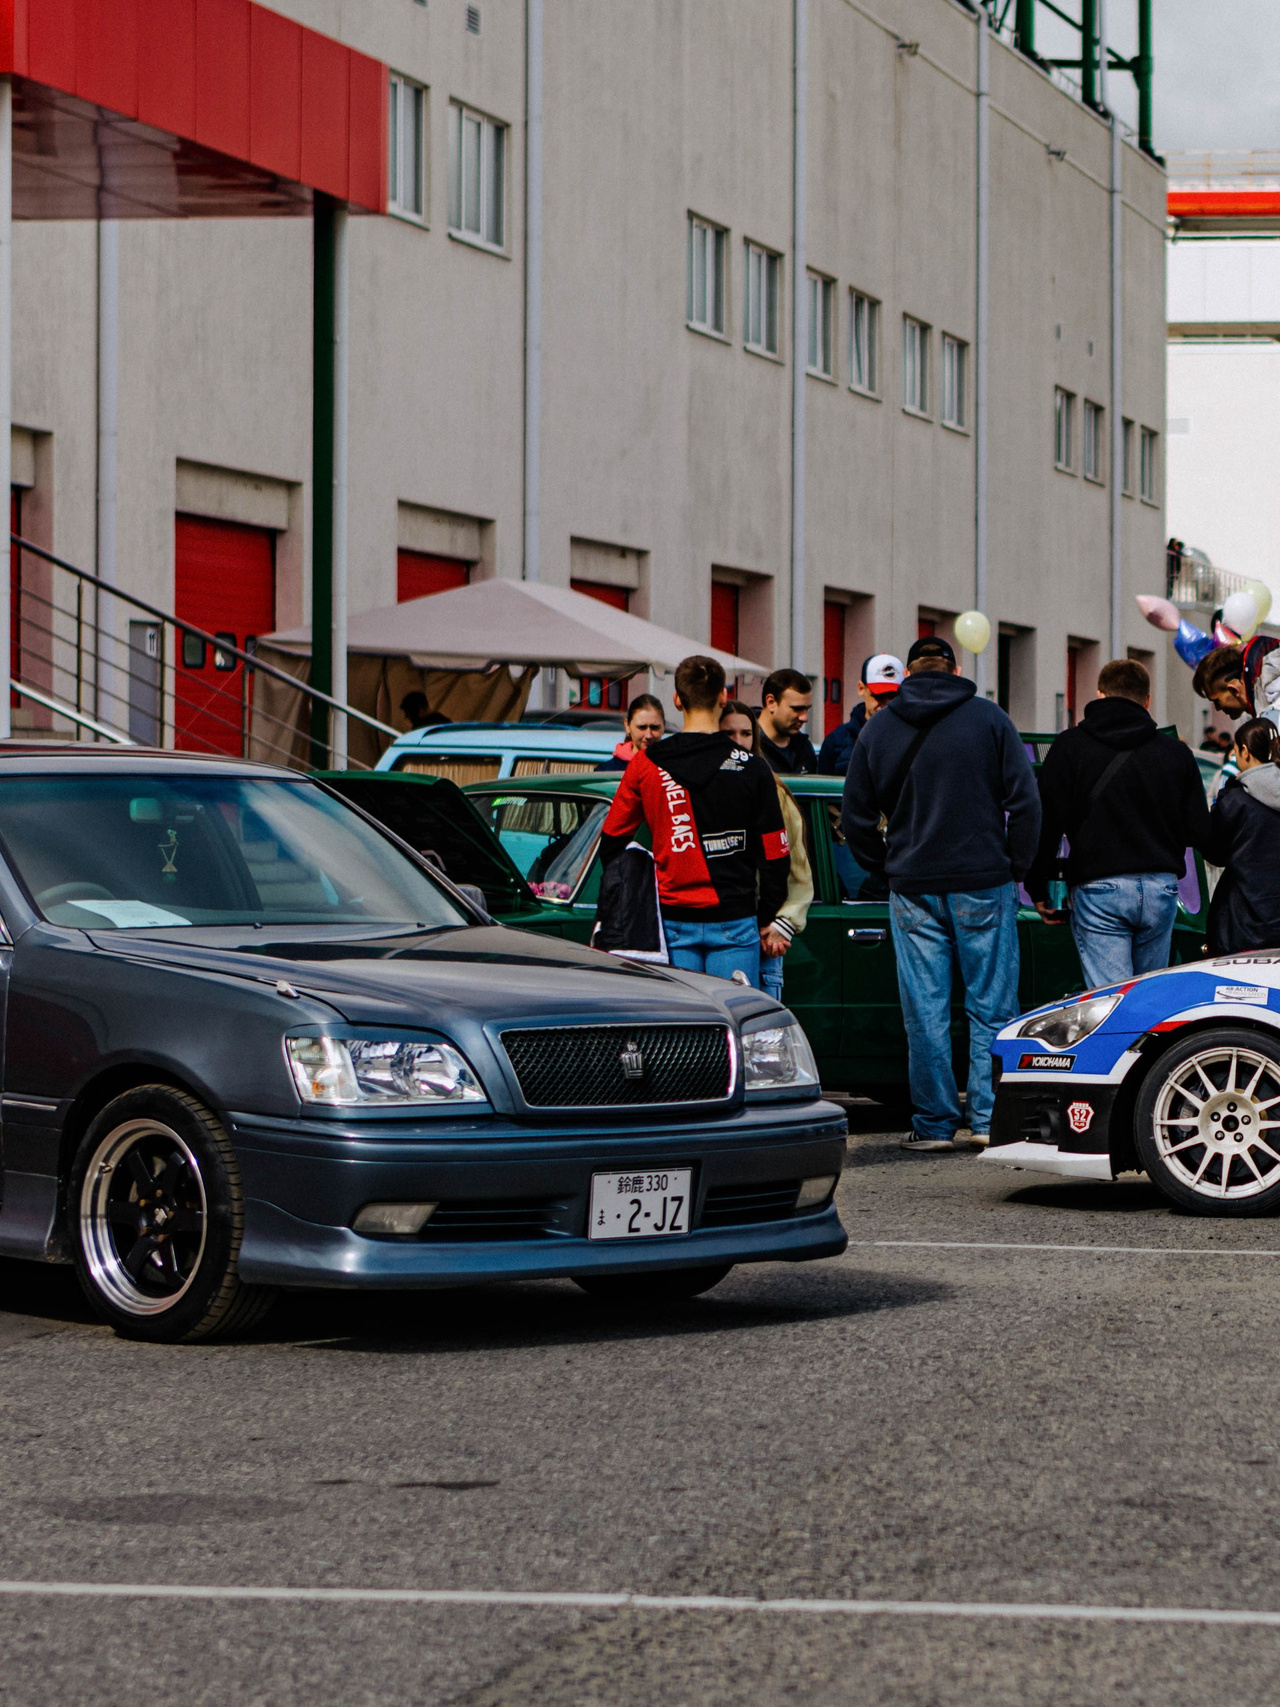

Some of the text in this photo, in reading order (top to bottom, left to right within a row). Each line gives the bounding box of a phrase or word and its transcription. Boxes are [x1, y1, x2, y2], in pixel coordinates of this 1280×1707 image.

[658, 766, 696, 853] NNEL BAES
[1031, 1056, 1071, 1068] YOKOHAMA
[1074, 1108, 1087, 1121] 52
